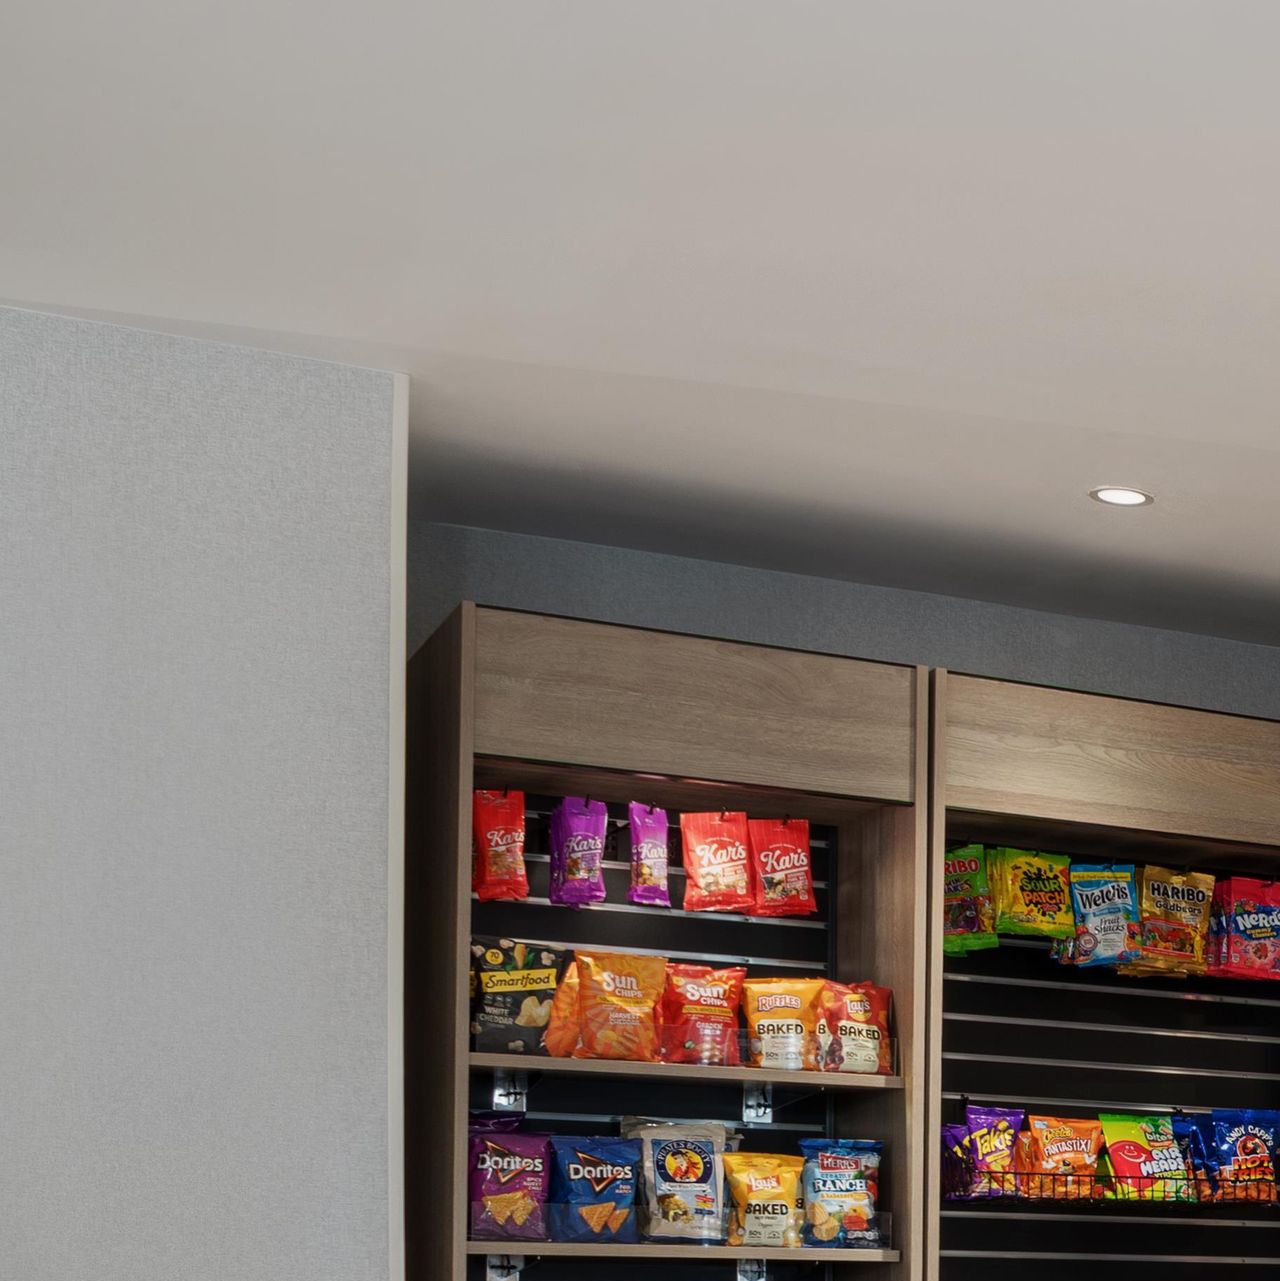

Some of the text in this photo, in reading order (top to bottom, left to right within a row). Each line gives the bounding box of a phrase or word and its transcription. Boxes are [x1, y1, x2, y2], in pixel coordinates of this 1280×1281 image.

[696, 843, 746, 865] Kar's
[760, 849, 808, 871] Kar's
[1021, 879, 1060, 892] SOUR
[1151, 882, 1206, 903] HARIBO
[1023, 892, 1065, 904] PATCH
[1078, 884, 1129, 909] Welch's
[1099, 916, 1122, 925] Fruit
[1094, 923, 1125, 934] Snacks
[485, 972, 551, 989] Smartfood
[603, 972, 639, 991] Sun
[616, 989, 643, 998] CHIPS
[685, 984, 725, 1002] Sun
[700, 997, 728, 1007] CHIPS
[758, 995, 801, 1011] RUFFLES
[844, 996, 870, 1016] Lay's
[484, 1006, 510, 1015] WHITE
[479, 1014, 514, 1025] CHEDDAR
[757, 1023, 804, 1035] BAKED
[839, 1026, 881, 1040] BAKED
[971, 1121, 1015, 1160] Takis
[1226, 1125, 1274, 1146] ANDY CAPP'S
[1151, 1148, 1181, 1160] AIR
[477, 1152, 544, 1172] Doritos
[822, 1157, 859, 1169] HERR'S
[1140, 1158, 1185, 1176] HEADS
[1233, 1157, 1270, 1169] HOT
[569, 1163, 633, 1180] Doritos
[1231, 1168, 1274, 1181] FRIES
[749, 1173, 779, 1193] Lay's
[814, 1179, 868, 1192] RANCH
[745, 1203, 788, 1215] BAKED
